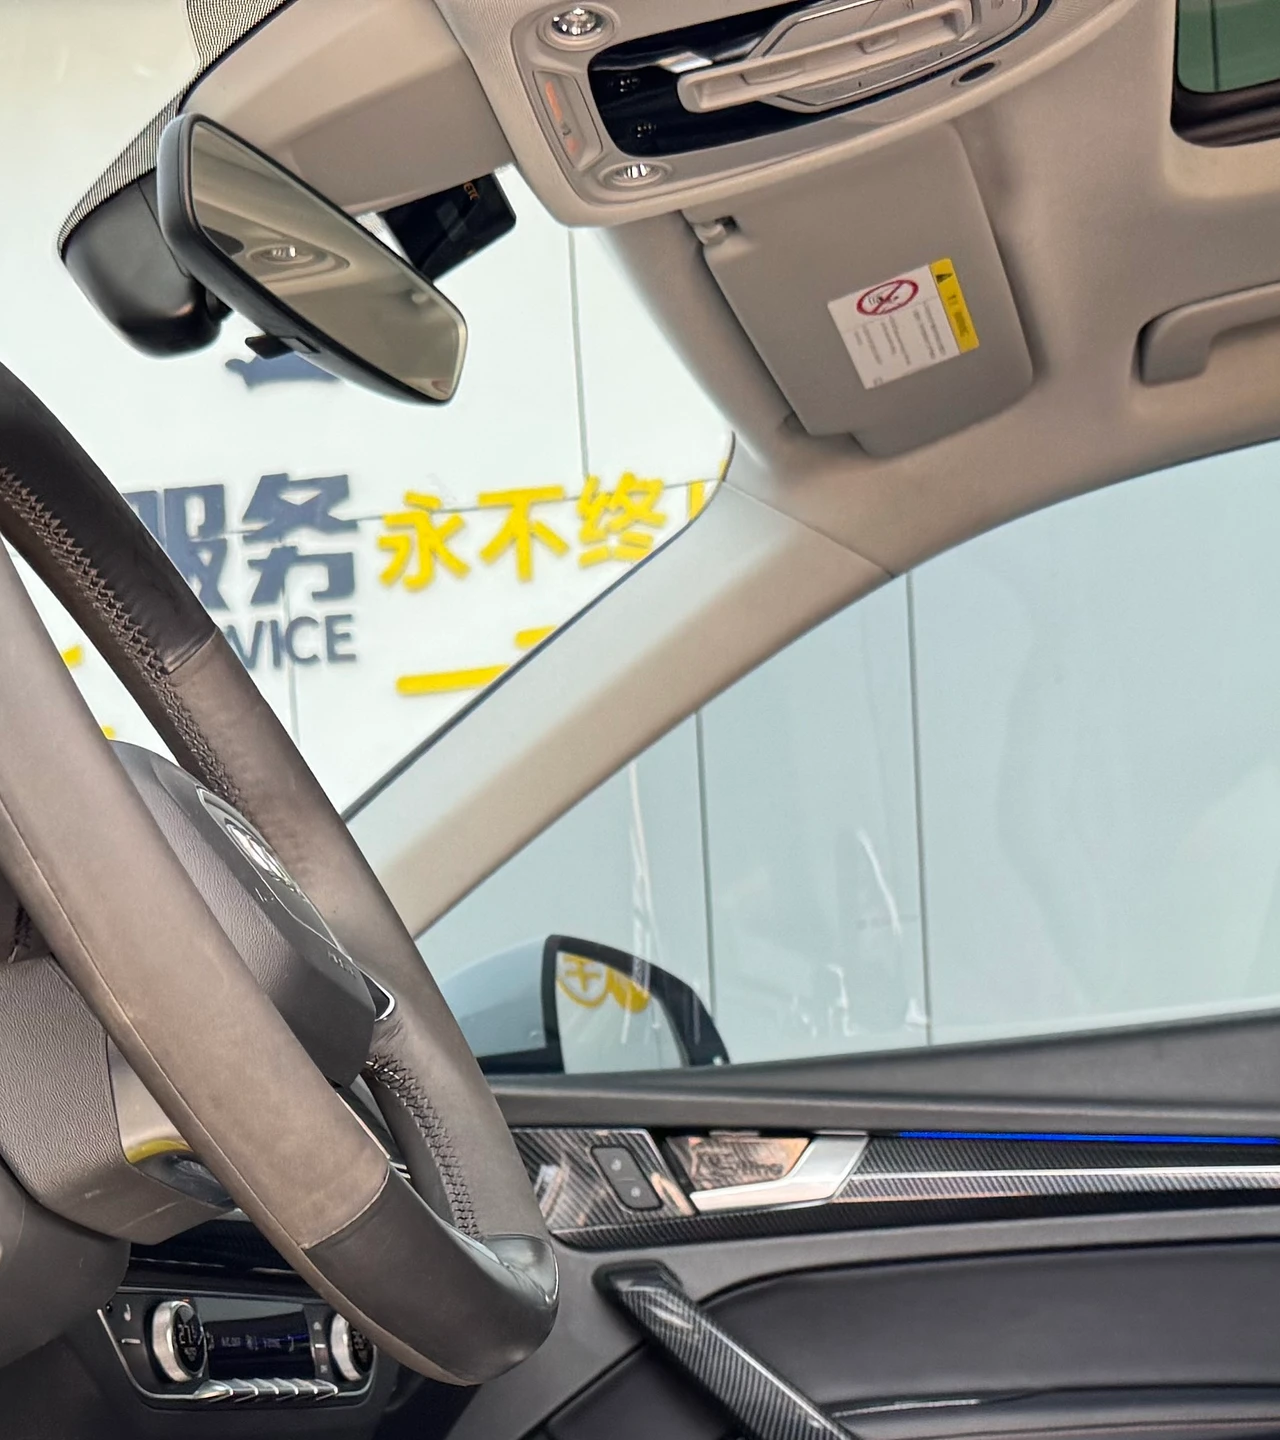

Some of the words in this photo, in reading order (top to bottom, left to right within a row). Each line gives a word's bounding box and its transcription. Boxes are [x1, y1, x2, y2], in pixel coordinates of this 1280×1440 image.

[376, 470, 730, 590] 永不终
[227, 613, 357, 669] VICE
